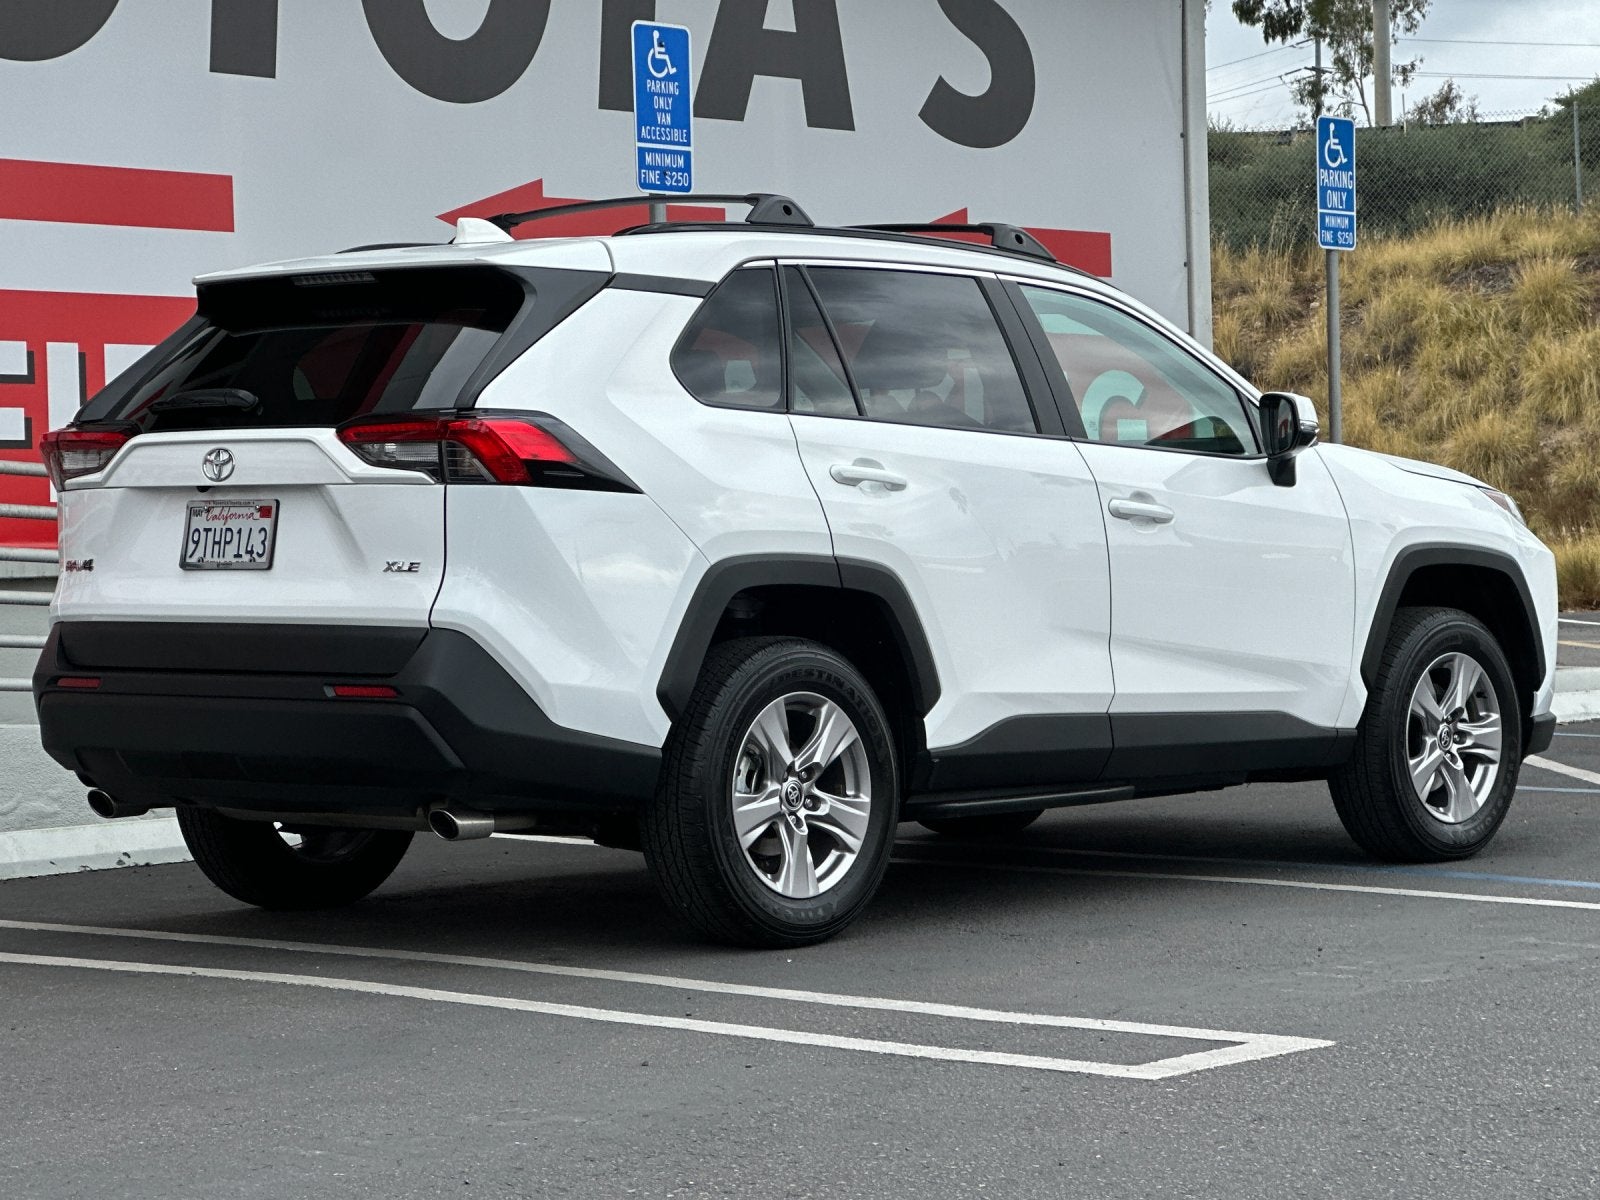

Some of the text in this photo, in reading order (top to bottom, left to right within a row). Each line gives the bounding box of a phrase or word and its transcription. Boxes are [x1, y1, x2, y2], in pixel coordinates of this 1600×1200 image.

[646, 79, 680, 95] PARKING
[653, 96, 673, 110] ONLY
[656, 112, 671, 125] VAN
[641, 126, 688, 142] ACCESSIBLE
[645, 152, 684, 168] MINIMUM
[641, 169, 689, 186] FINE $250
[1320, 169, 1353, 189] PARKING
[1326, 190, 1347, 209] ONLY
[1325, 215, 1349, 229] MINIMUM
[1321, 230, 1353, 245] FINE $250
[205, 506, 260, 526] California
[189, 527, 267, 558] 9THP143
[382, 561, 421, 572] XLE
